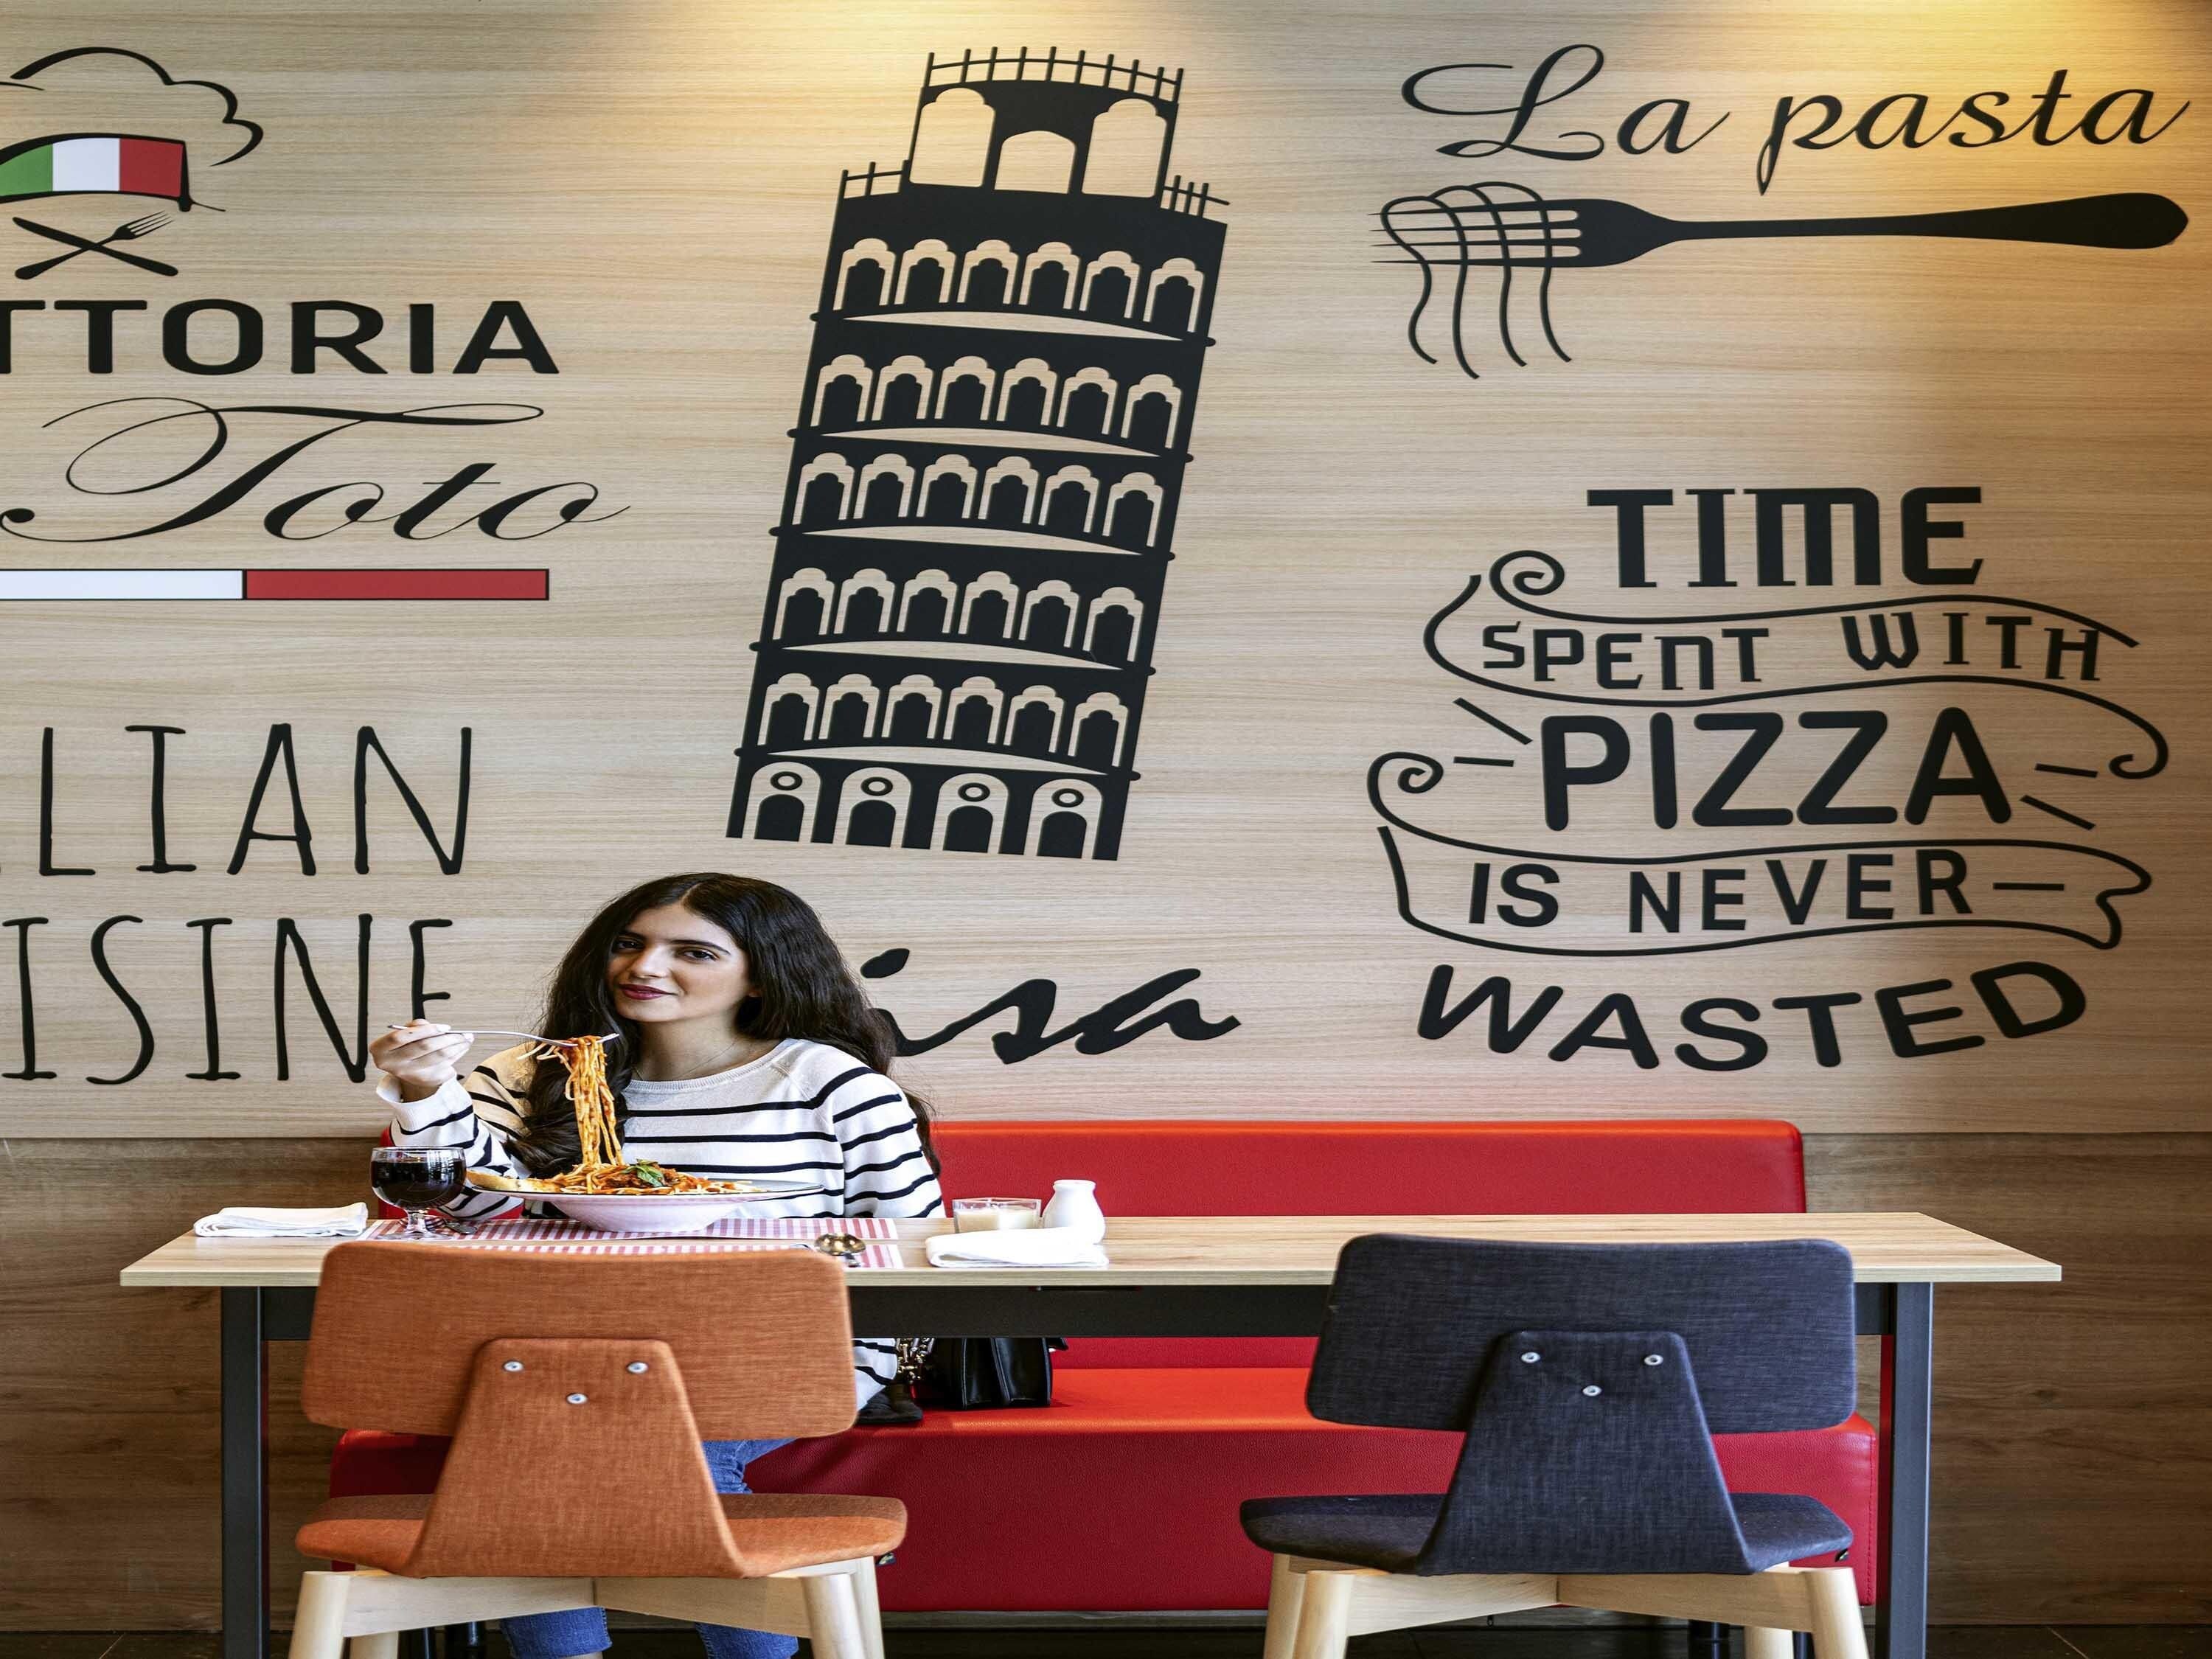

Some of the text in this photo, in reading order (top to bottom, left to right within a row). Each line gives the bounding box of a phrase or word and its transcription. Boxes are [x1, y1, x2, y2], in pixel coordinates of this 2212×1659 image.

[1402, 44, 2191, 195] La pasta
[0, 397, 631, 543] Toto
[1587, 486, 1984, 588] TIME
[1482, 611, 2101, 691] SPENT WITH
[1541, 706, 2014, 832] PIZZA
[1468, 848, 1974, 933] IS NEVER
[1417, 961, 2087, 1071] WASTED
